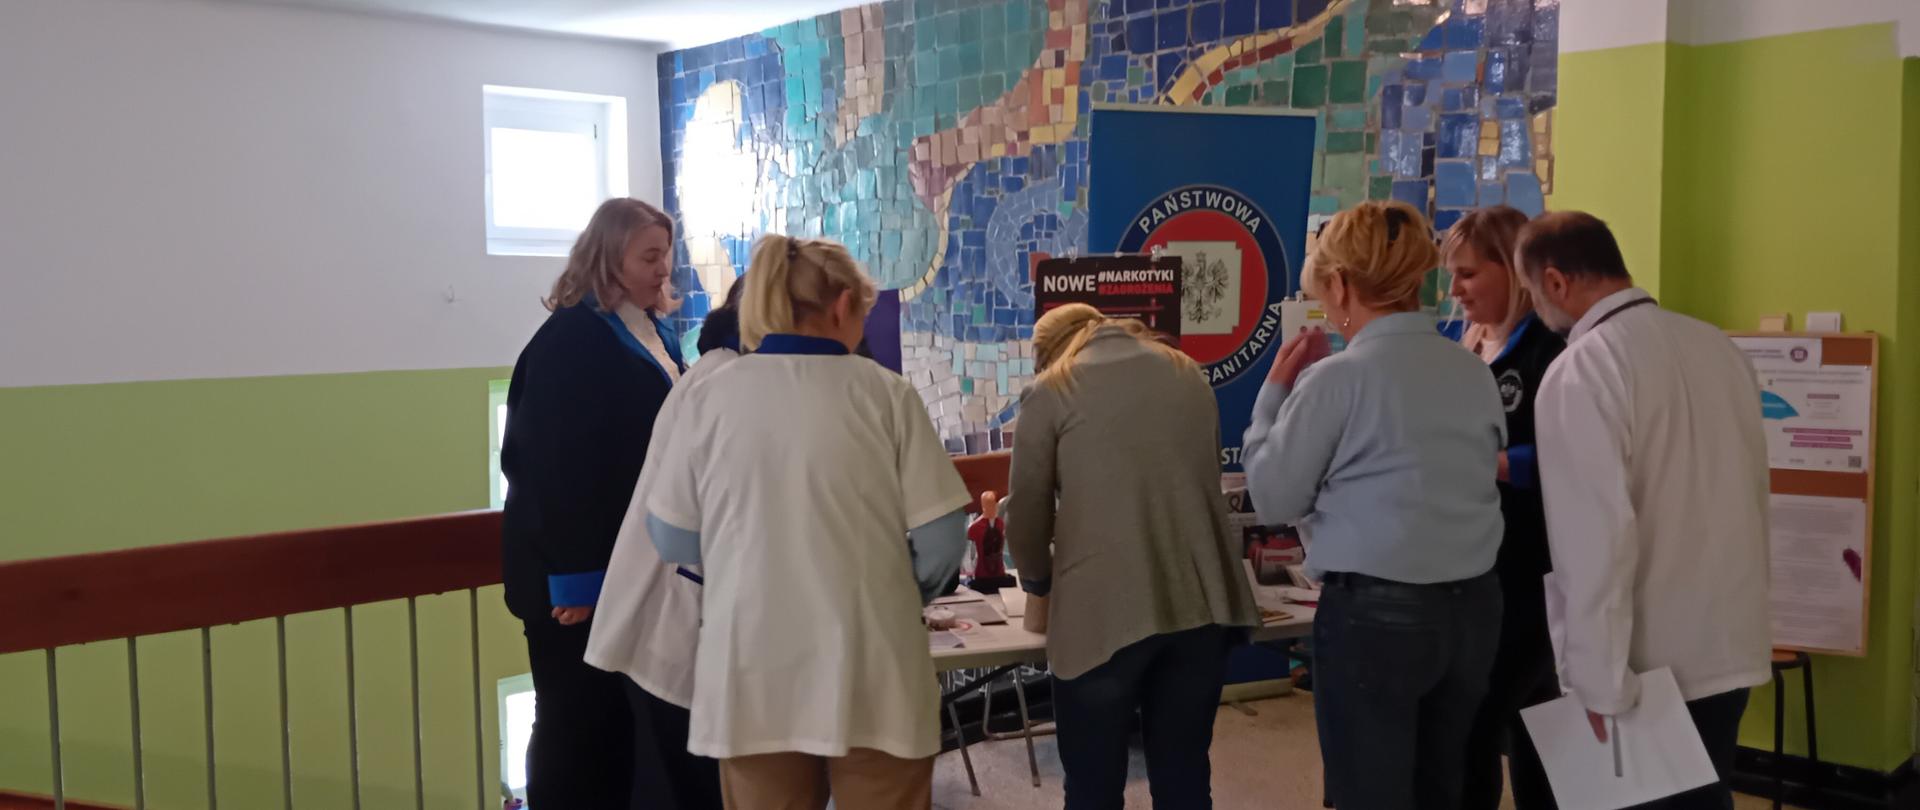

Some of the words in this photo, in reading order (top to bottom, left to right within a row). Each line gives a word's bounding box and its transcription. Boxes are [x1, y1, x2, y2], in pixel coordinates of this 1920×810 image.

[1138, 190, 1261, 234] PAŃSTWOWA
[1043, 274, 1096, 293] NOWE
[1098, 269, 1174, 283] #NARKOTYKI
